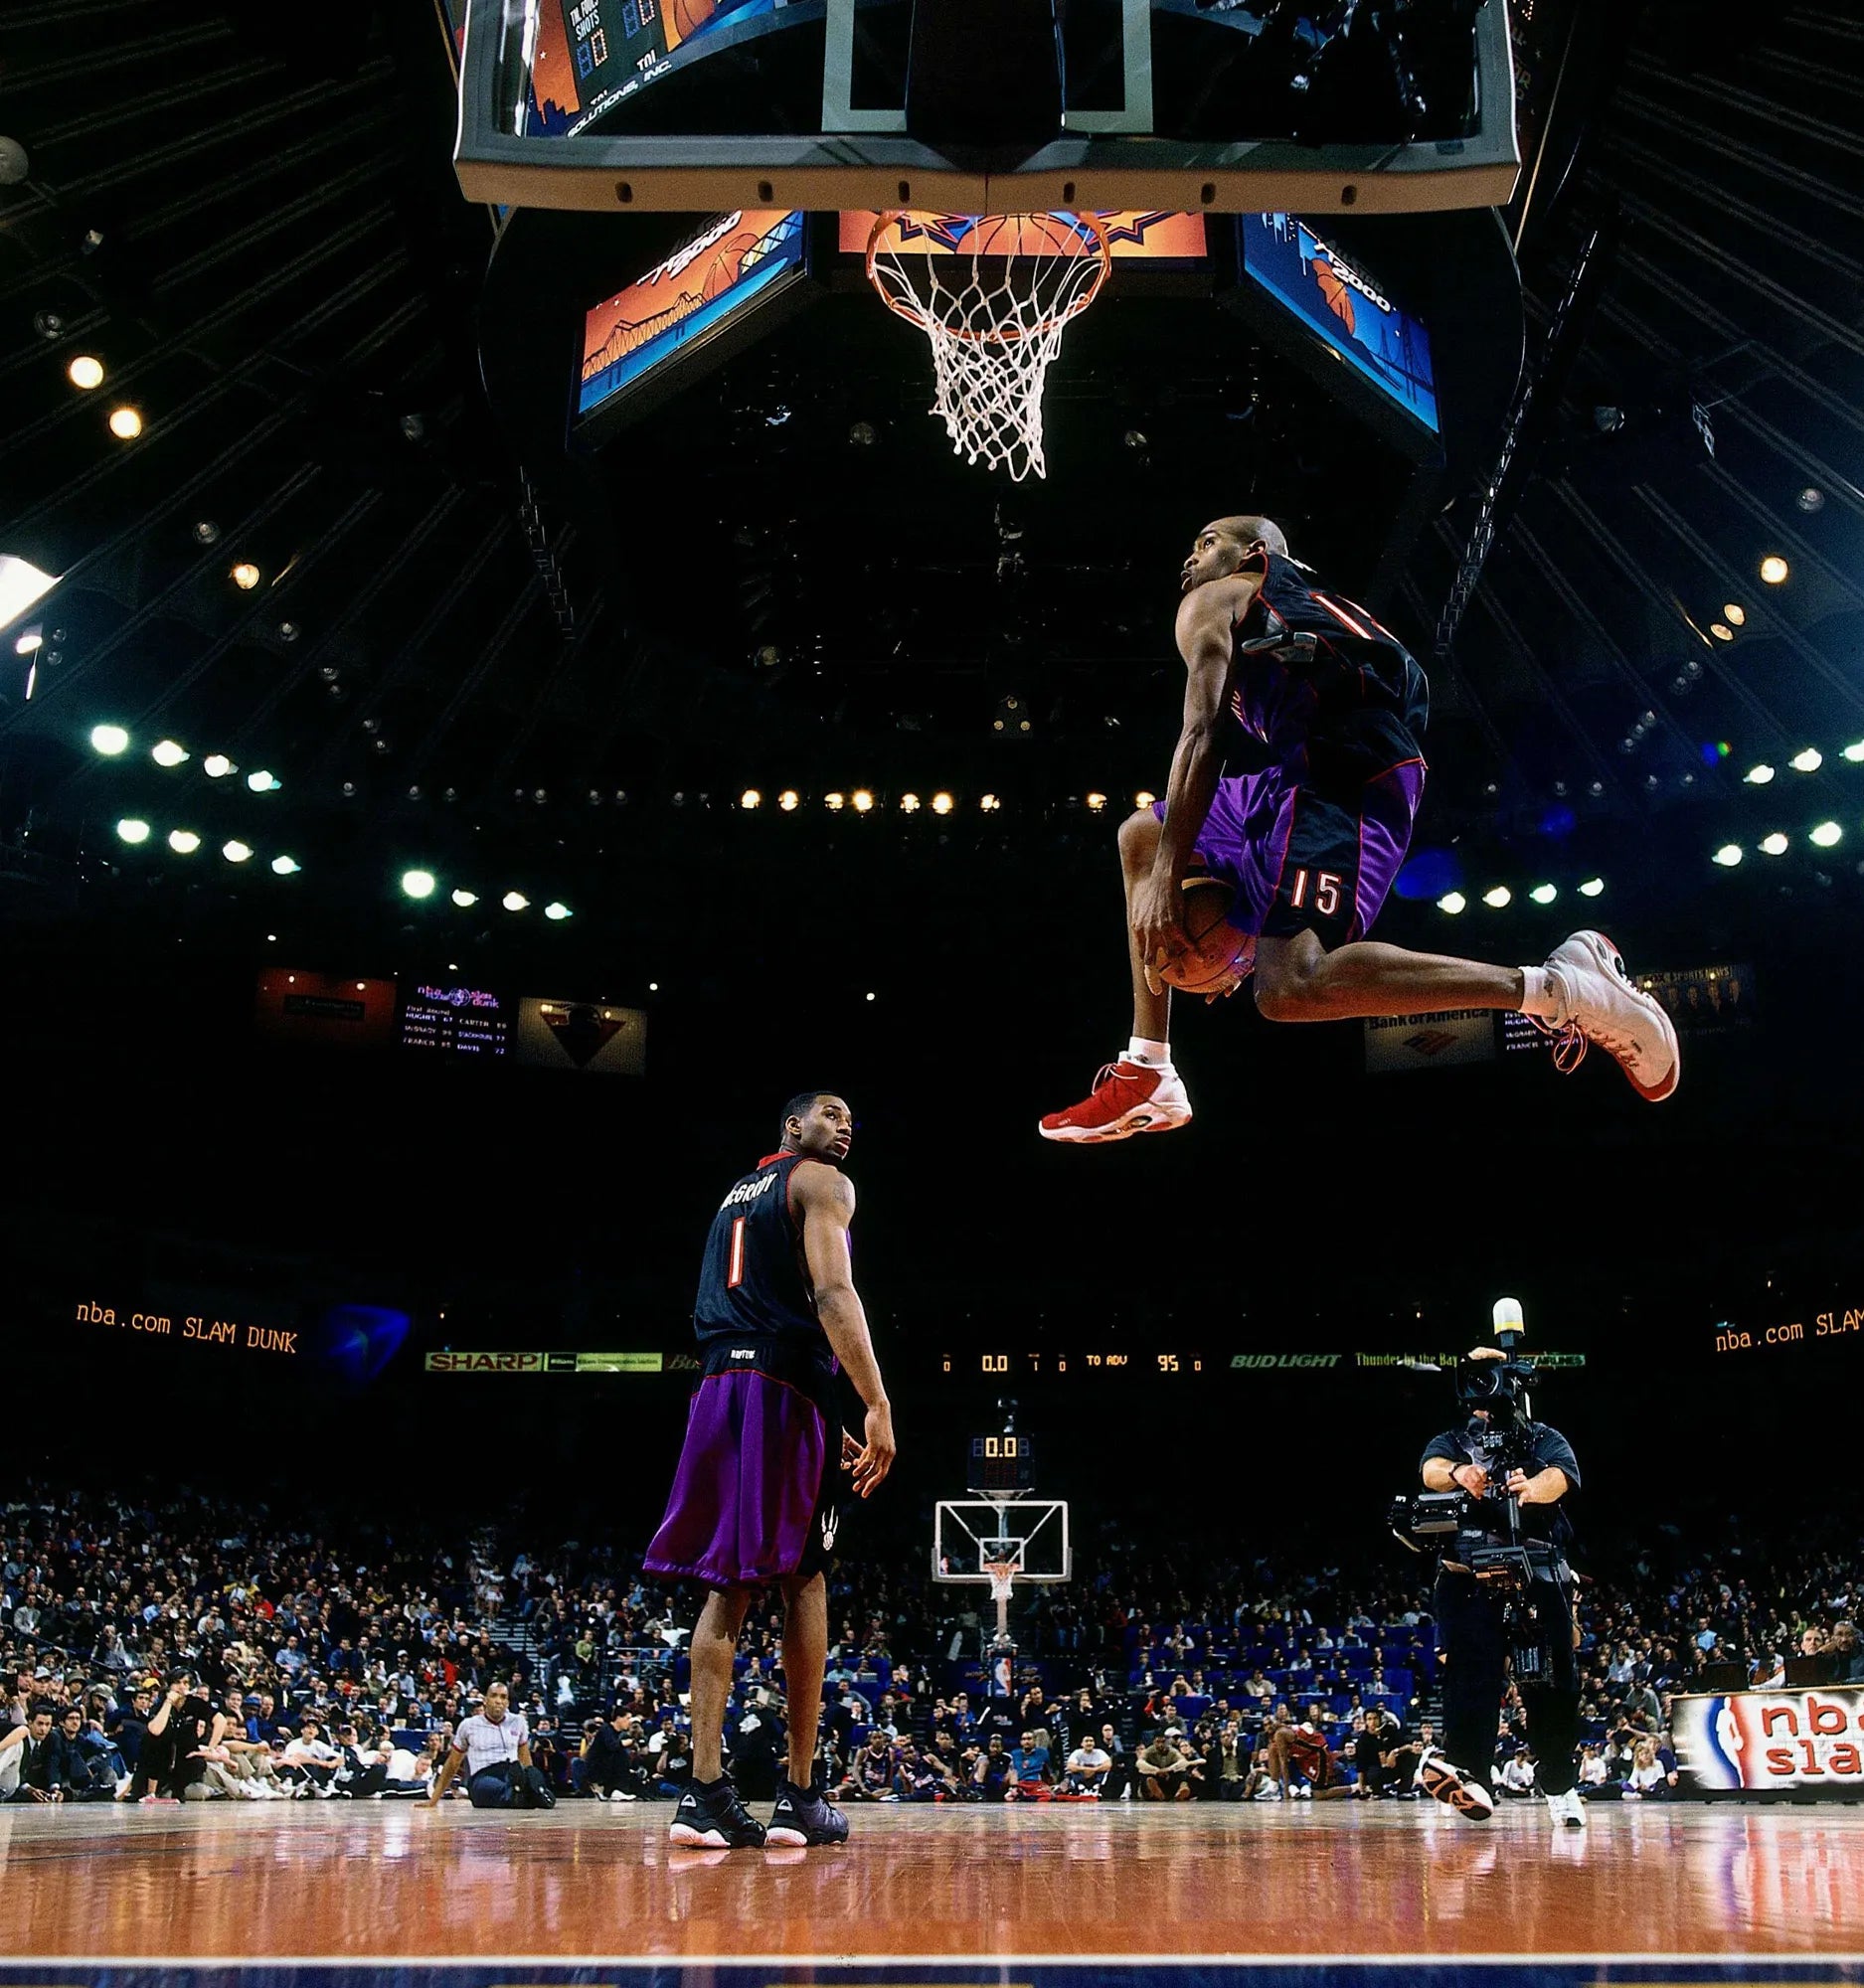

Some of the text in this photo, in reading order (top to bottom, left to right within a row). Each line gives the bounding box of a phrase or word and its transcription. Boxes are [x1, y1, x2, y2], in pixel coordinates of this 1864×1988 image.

[576, 9, 599, 41] SHOTS
[643, 60, 672, 82] INC.
[1332, 259, 1392, 313] 2000
[1291, 869, 1342, 915] 15
[1370, 1015, 1407, 1029] Bank
[727, 1216, 747, 1288] 1
[76, 1301, 298, 1354] nba.com SLAM DUNK
[1716, 1323, 1804, 1352] nba.com
[429, 1354, 538, 1371] SHARP
[981, 1355, 1009, 1373] 0.0
[1086, 1355, 1101, 1366] TO
[1105, 1355, 1128, 1366] ADV
[1156, 1355, 1180, 1372] 95
[1230, 1353, 1342, 1369] BUD LIGHT
[1354, 1352, 1400, 1367] Thunder
[1419, 1352, 1436, 1365] the
[1439, 1352, 1459, 1369] Bay
[985, 1437, 1017, 1458] 0.0
[1762, 1696, 1864, 1737] nb
